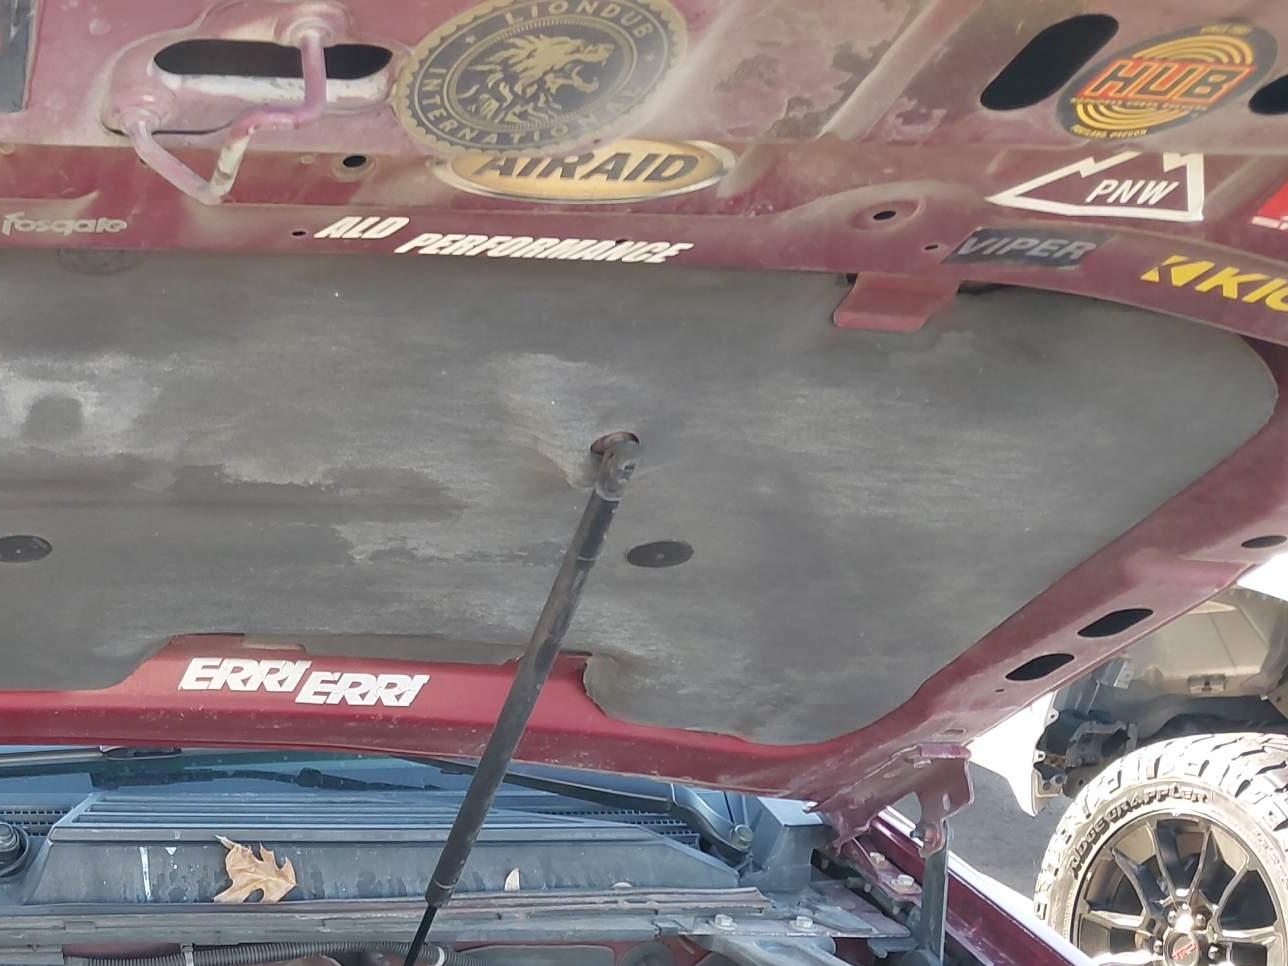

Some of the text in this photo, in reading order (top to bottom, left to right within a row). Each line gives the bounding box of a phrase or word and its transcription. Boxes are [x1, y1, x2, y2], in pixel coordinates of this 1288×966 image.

[505, 0, 653, 39] LIONDUB
[1083, 60, 1253, 103] HUB
[473, 152, 700, 184] AIRAID
[1085, 179, 1180, 206] PNW
[314, 216, 410, 240] ALD
[394, 233, 695, 264] PERFORMANCE
[959, 235, 1097, 260] VIPER
